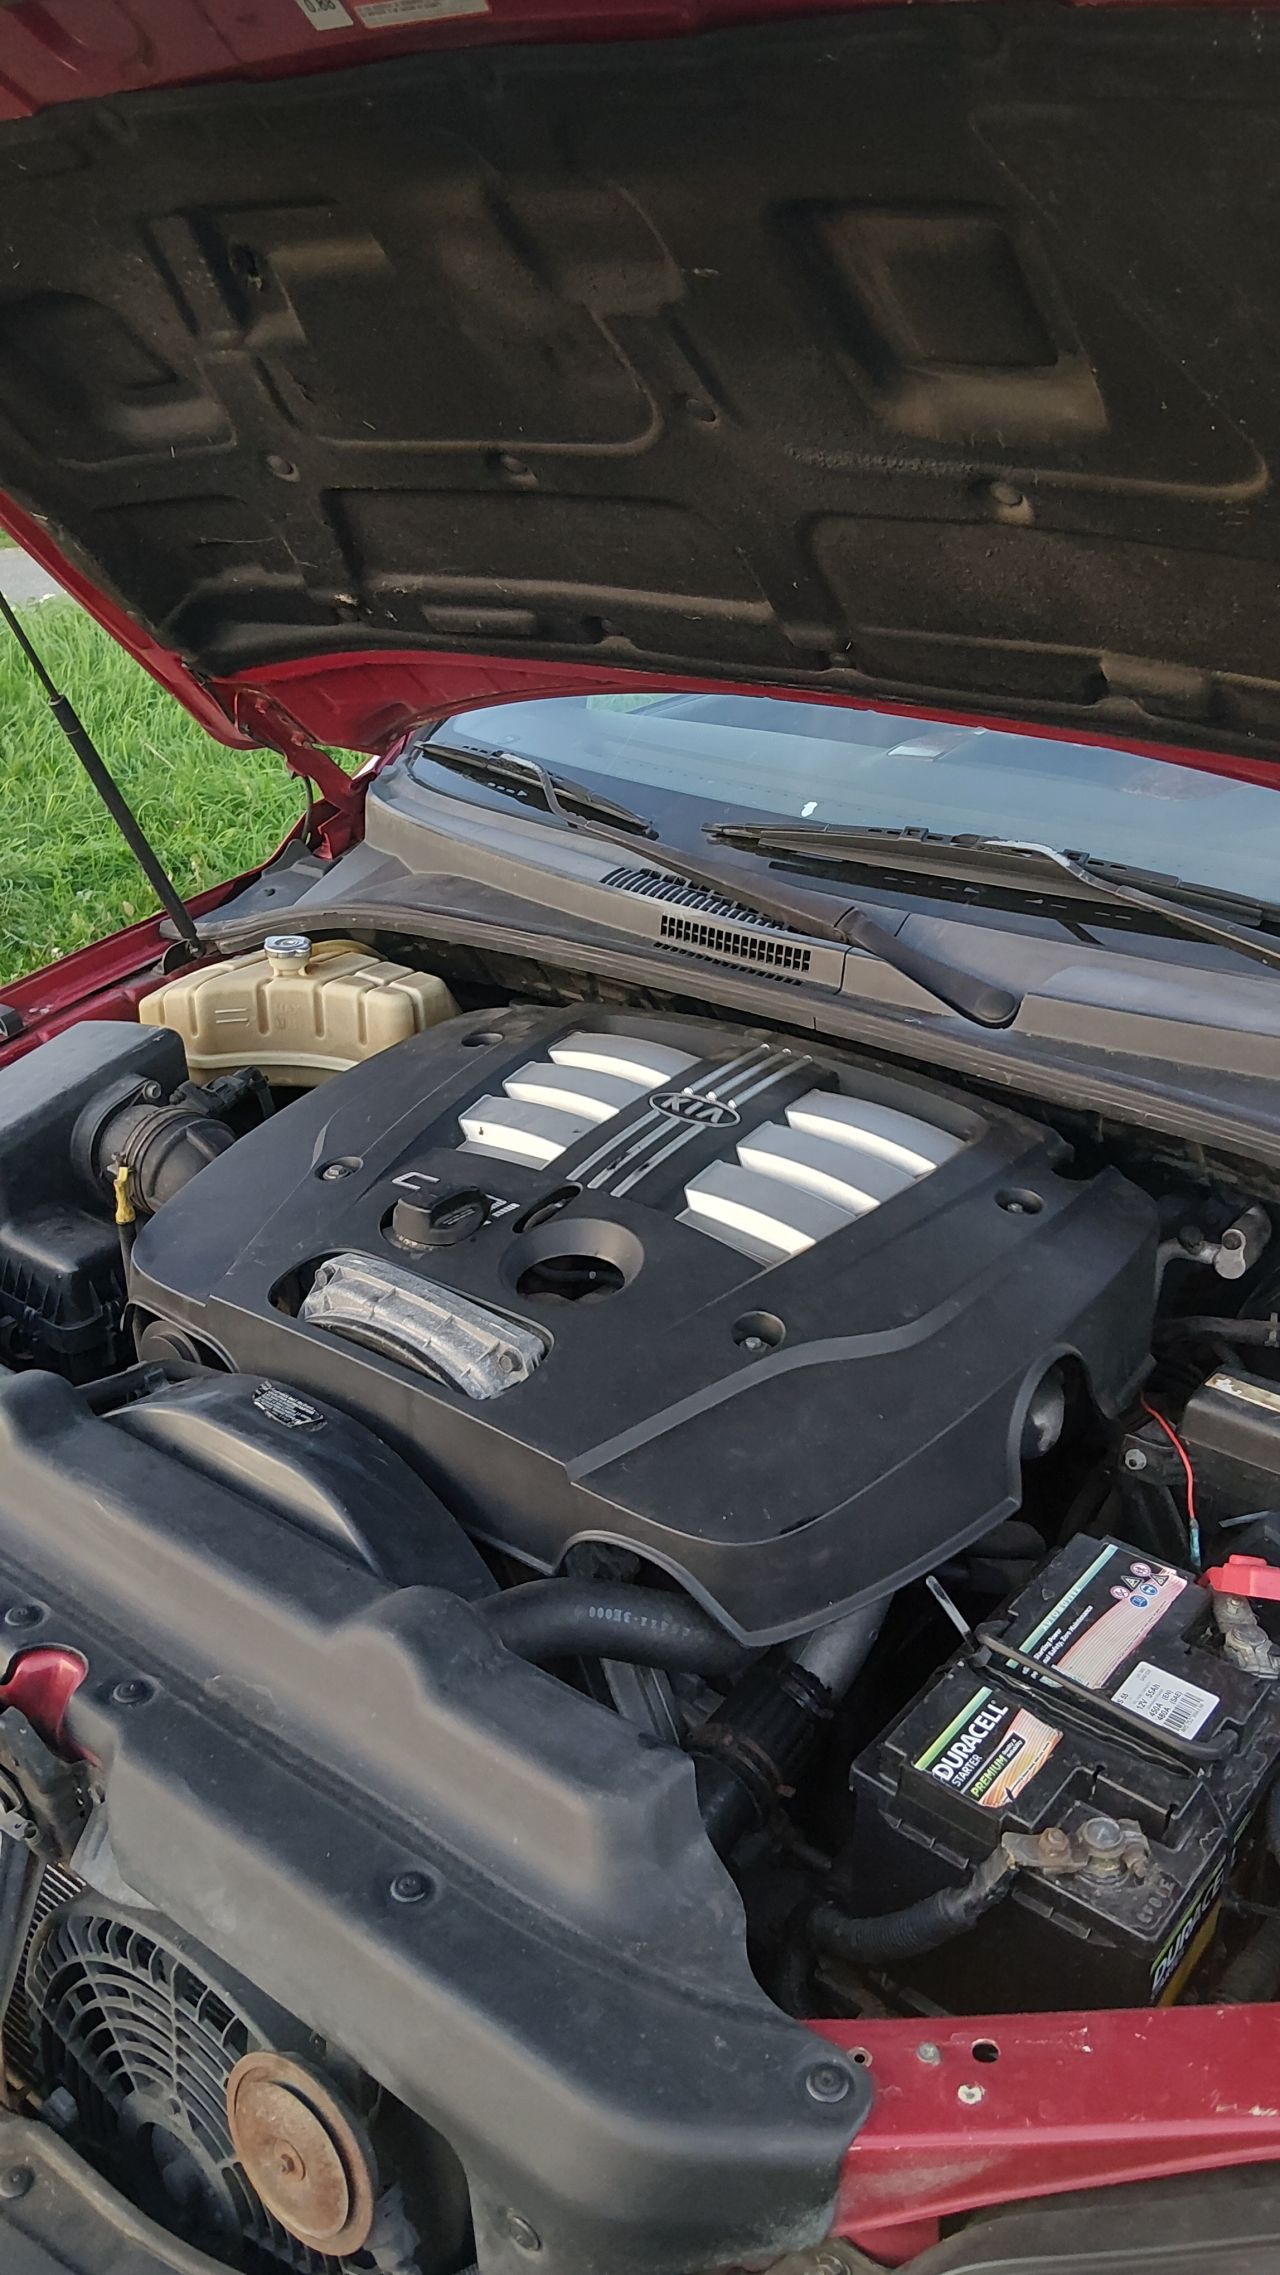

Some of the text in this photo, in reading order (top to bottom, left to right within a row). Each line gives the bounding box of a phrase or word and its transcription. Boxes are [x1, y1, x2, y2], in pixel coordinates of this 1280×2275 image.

[661, 1095, 722, 1123] KIA
[1136, 1699, 1148, 1710] 12V
[1145, 1683, 1161, 1698] 55Ah
[932, 1703, 1008, 1781] DURACELL
[952, 1754, 983, 1787] STARTER
[970, 1754, 1008, 1798] PREMIUM
